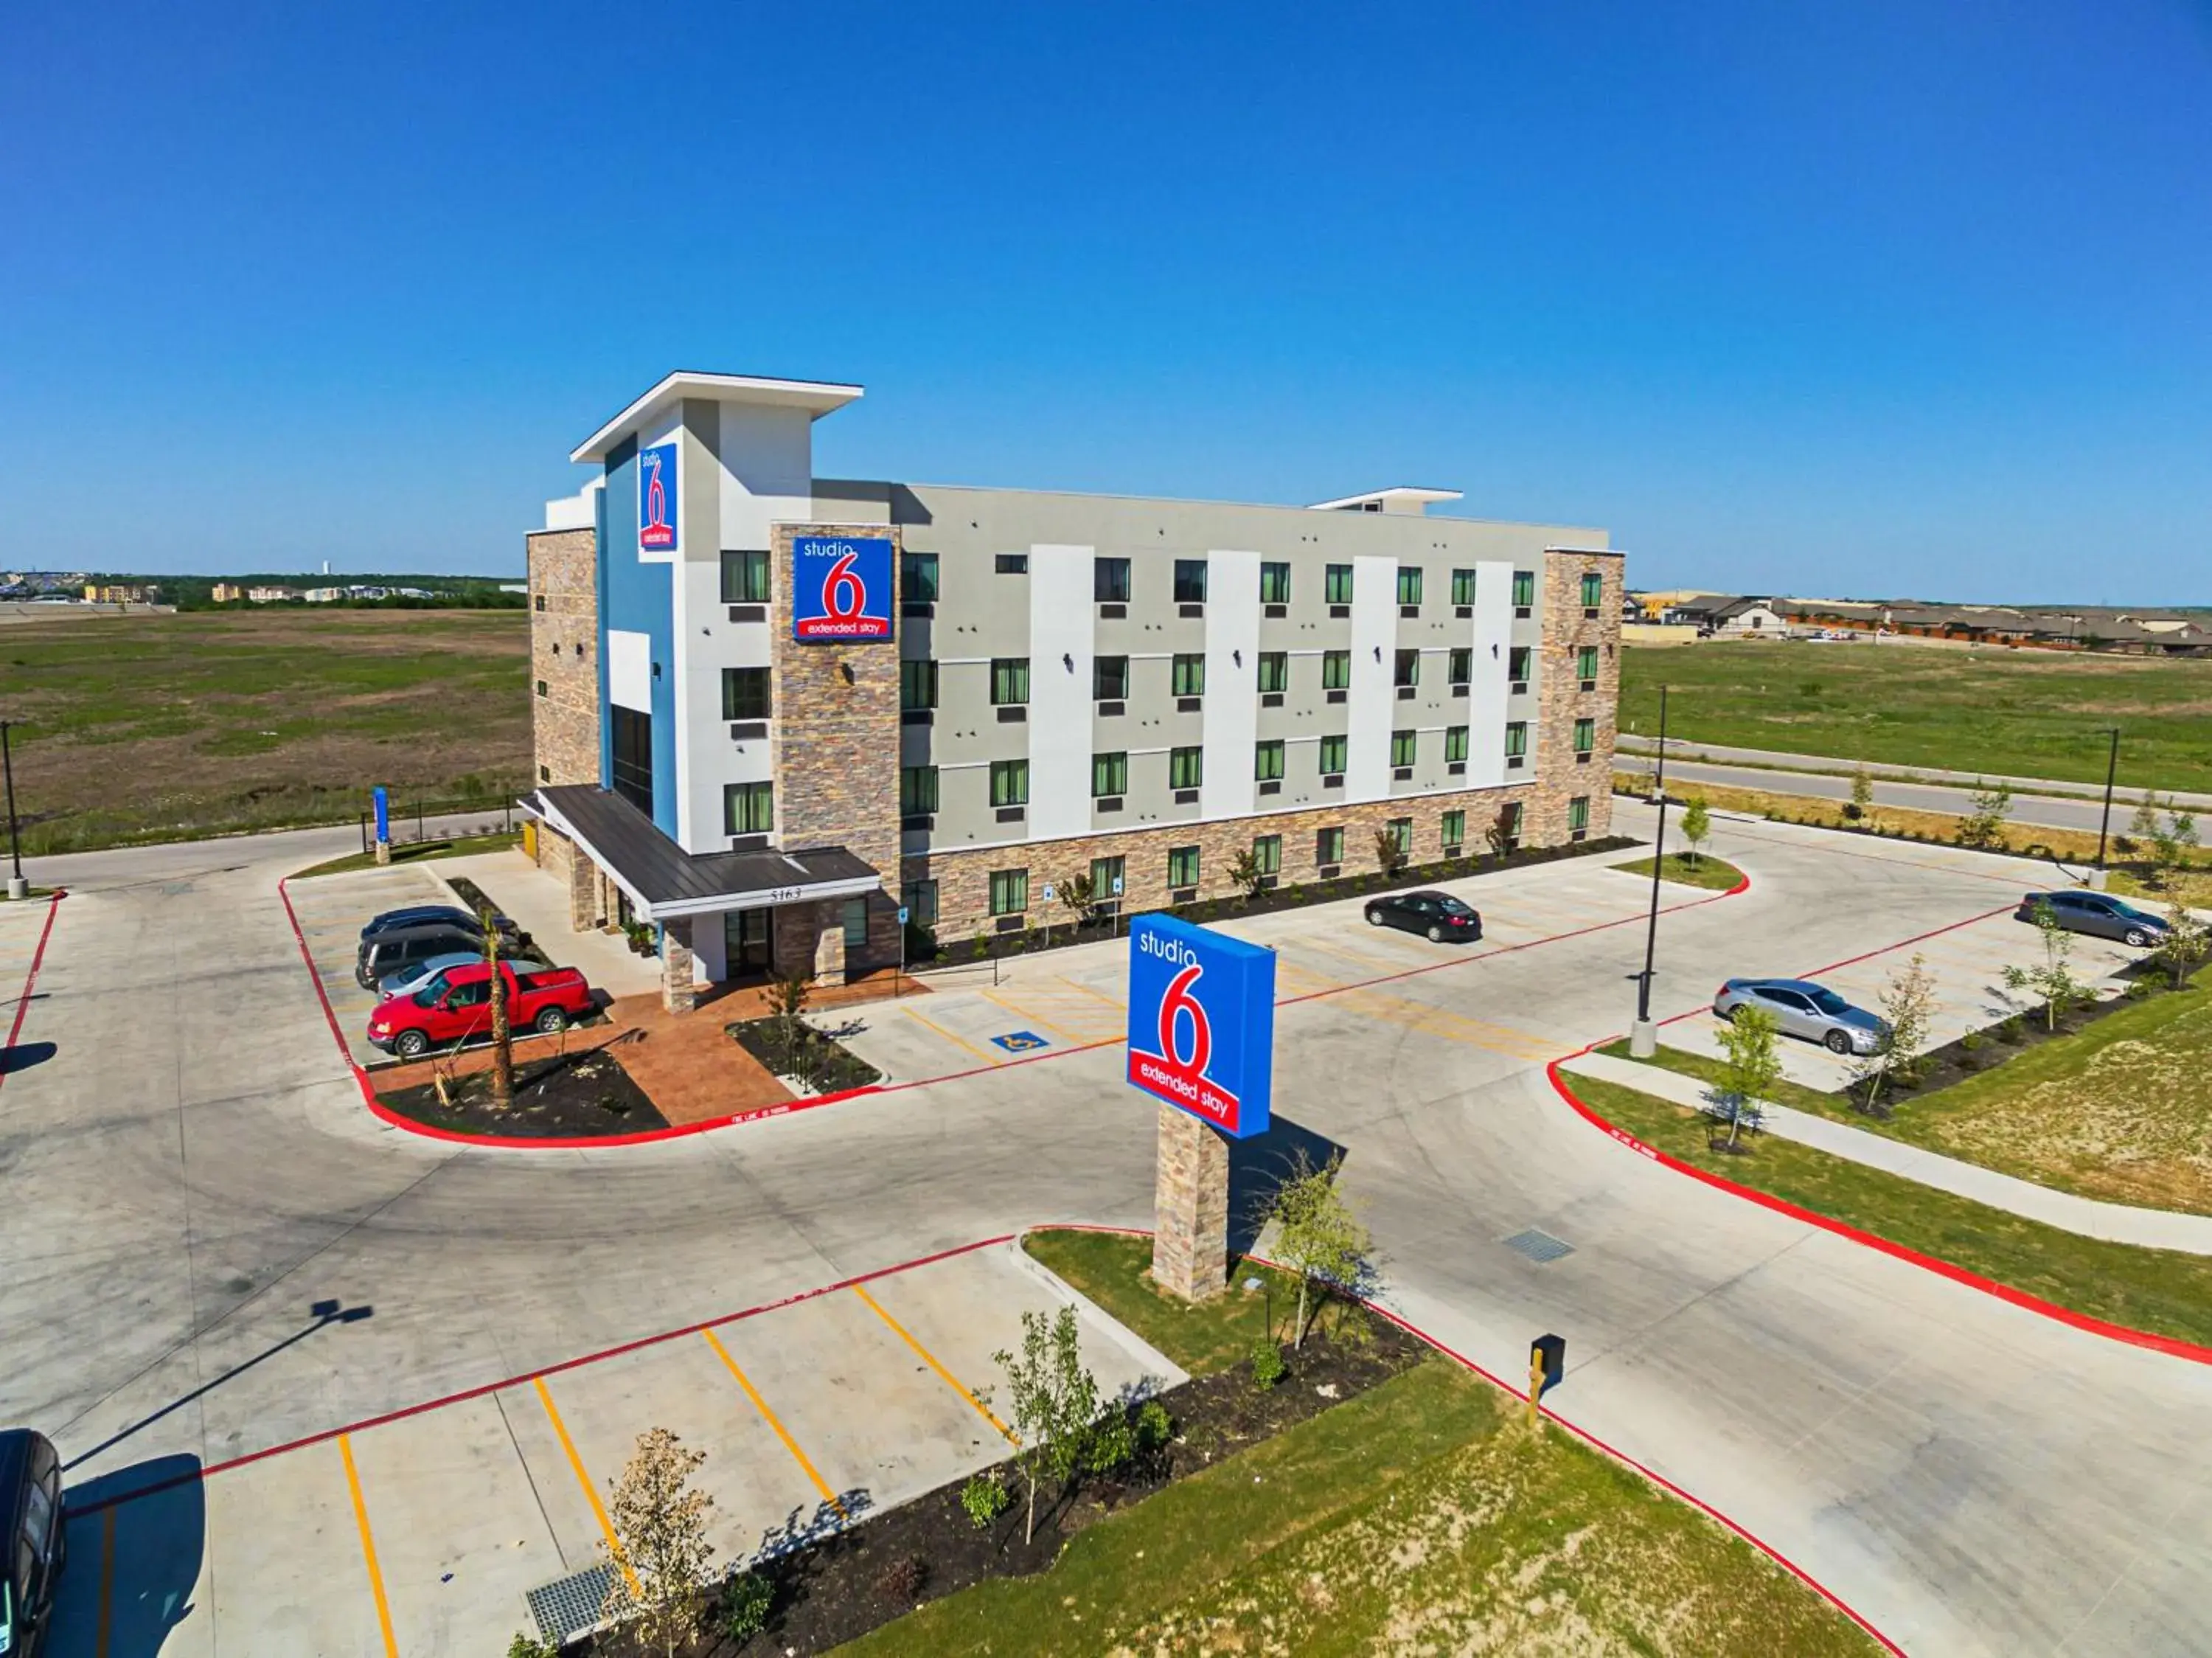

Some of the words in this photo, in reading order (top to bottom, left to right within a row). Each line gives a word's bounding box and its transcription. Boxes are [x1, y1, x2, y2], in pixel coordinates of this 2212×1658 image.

[648, 460, 666, 526] 6
[804, 541, 854, 557] studio
[822, 552, 866, 618] 6
[808, 622, 857, 634] extended
[860, 622, 880, 635] stay
[1139, 929, 1197, 968] studio
[1158, 964, 1211, 1078] 6
[1141, 1063, 1197, 1100] extended
[1200, 1091, 1229, 1118] stay
